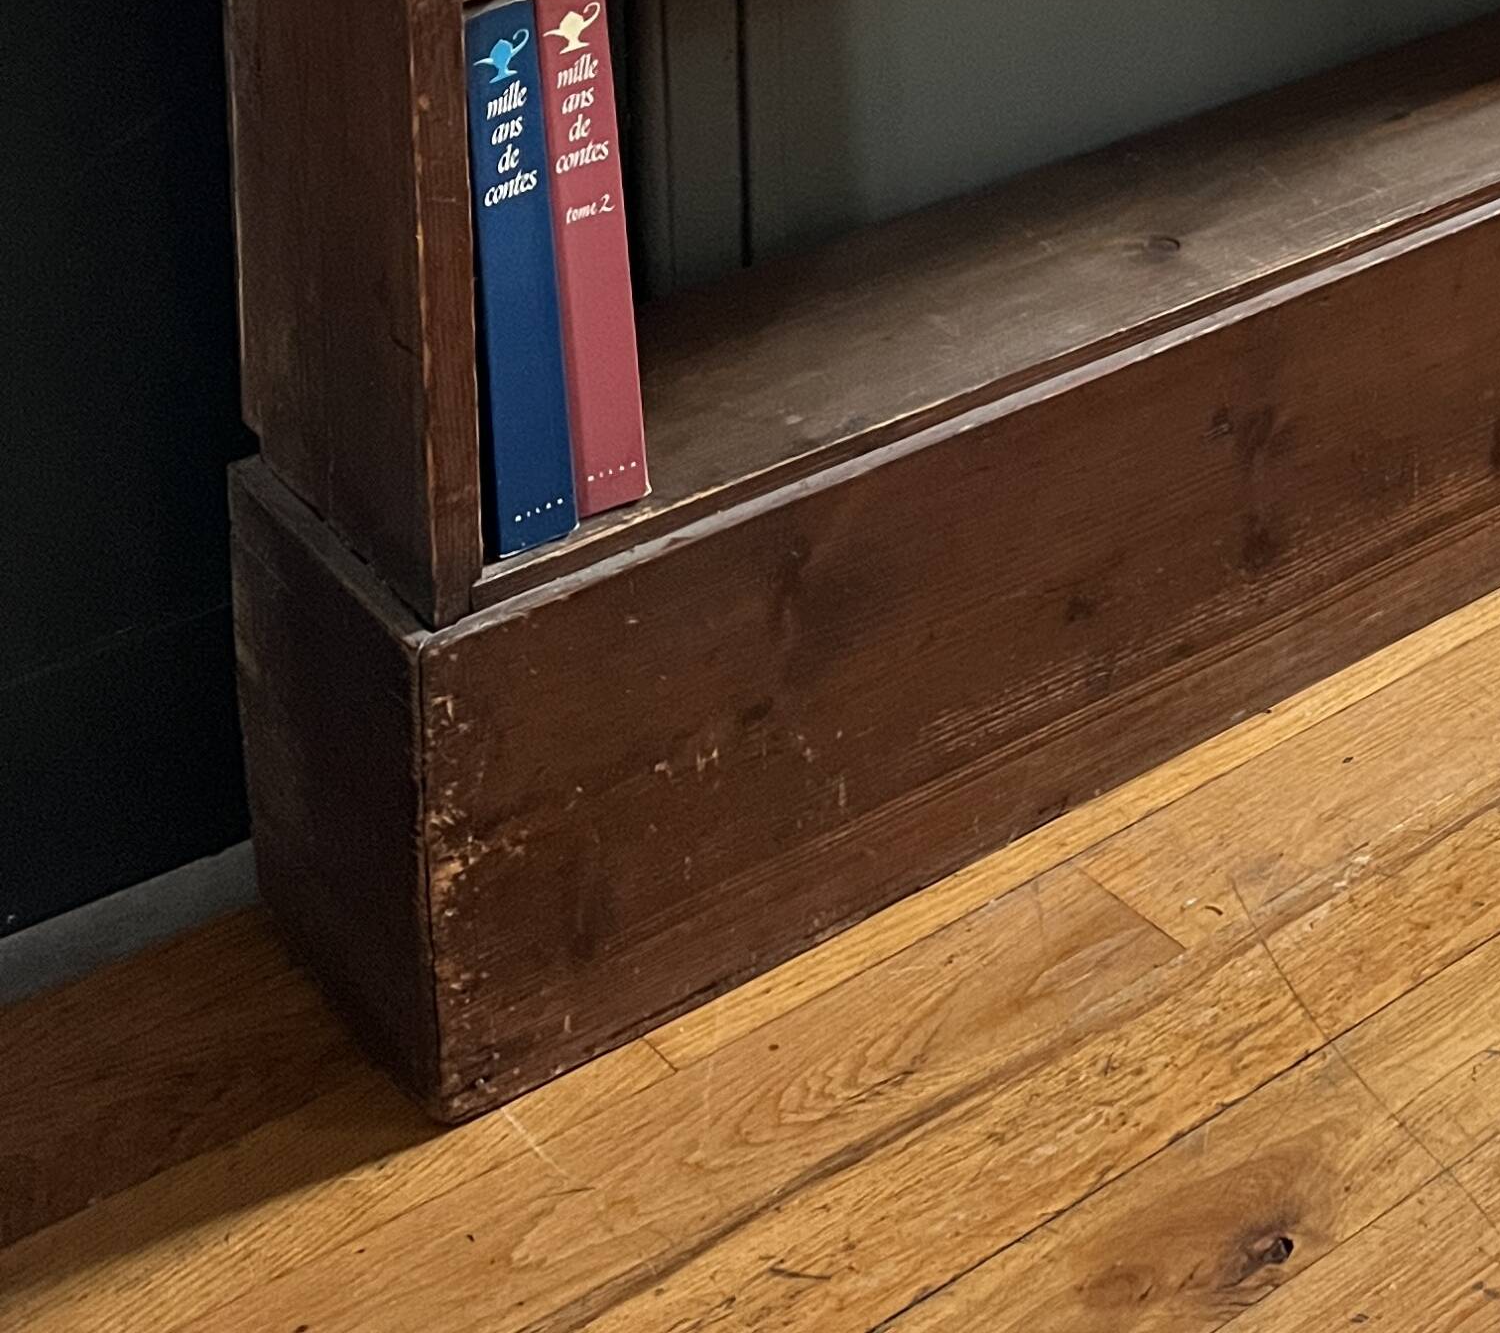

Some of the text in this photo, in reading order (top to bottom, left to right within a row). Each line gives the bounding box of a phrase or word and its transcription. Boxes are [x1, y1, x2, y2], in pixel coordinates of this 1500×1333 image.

[556, 53, 599, 89] mille
[487, 80, 527, 121] mille
[561, 87, 594, 115] ans
[491, 116, 523, 145] ans
[568, 114, 591, 142] de
[497, 144, 520, 173] de
[555, 140, 609, 174] contes
[484, 169, 538, 207] contes
[566, 193, 615, 225] tome 2
